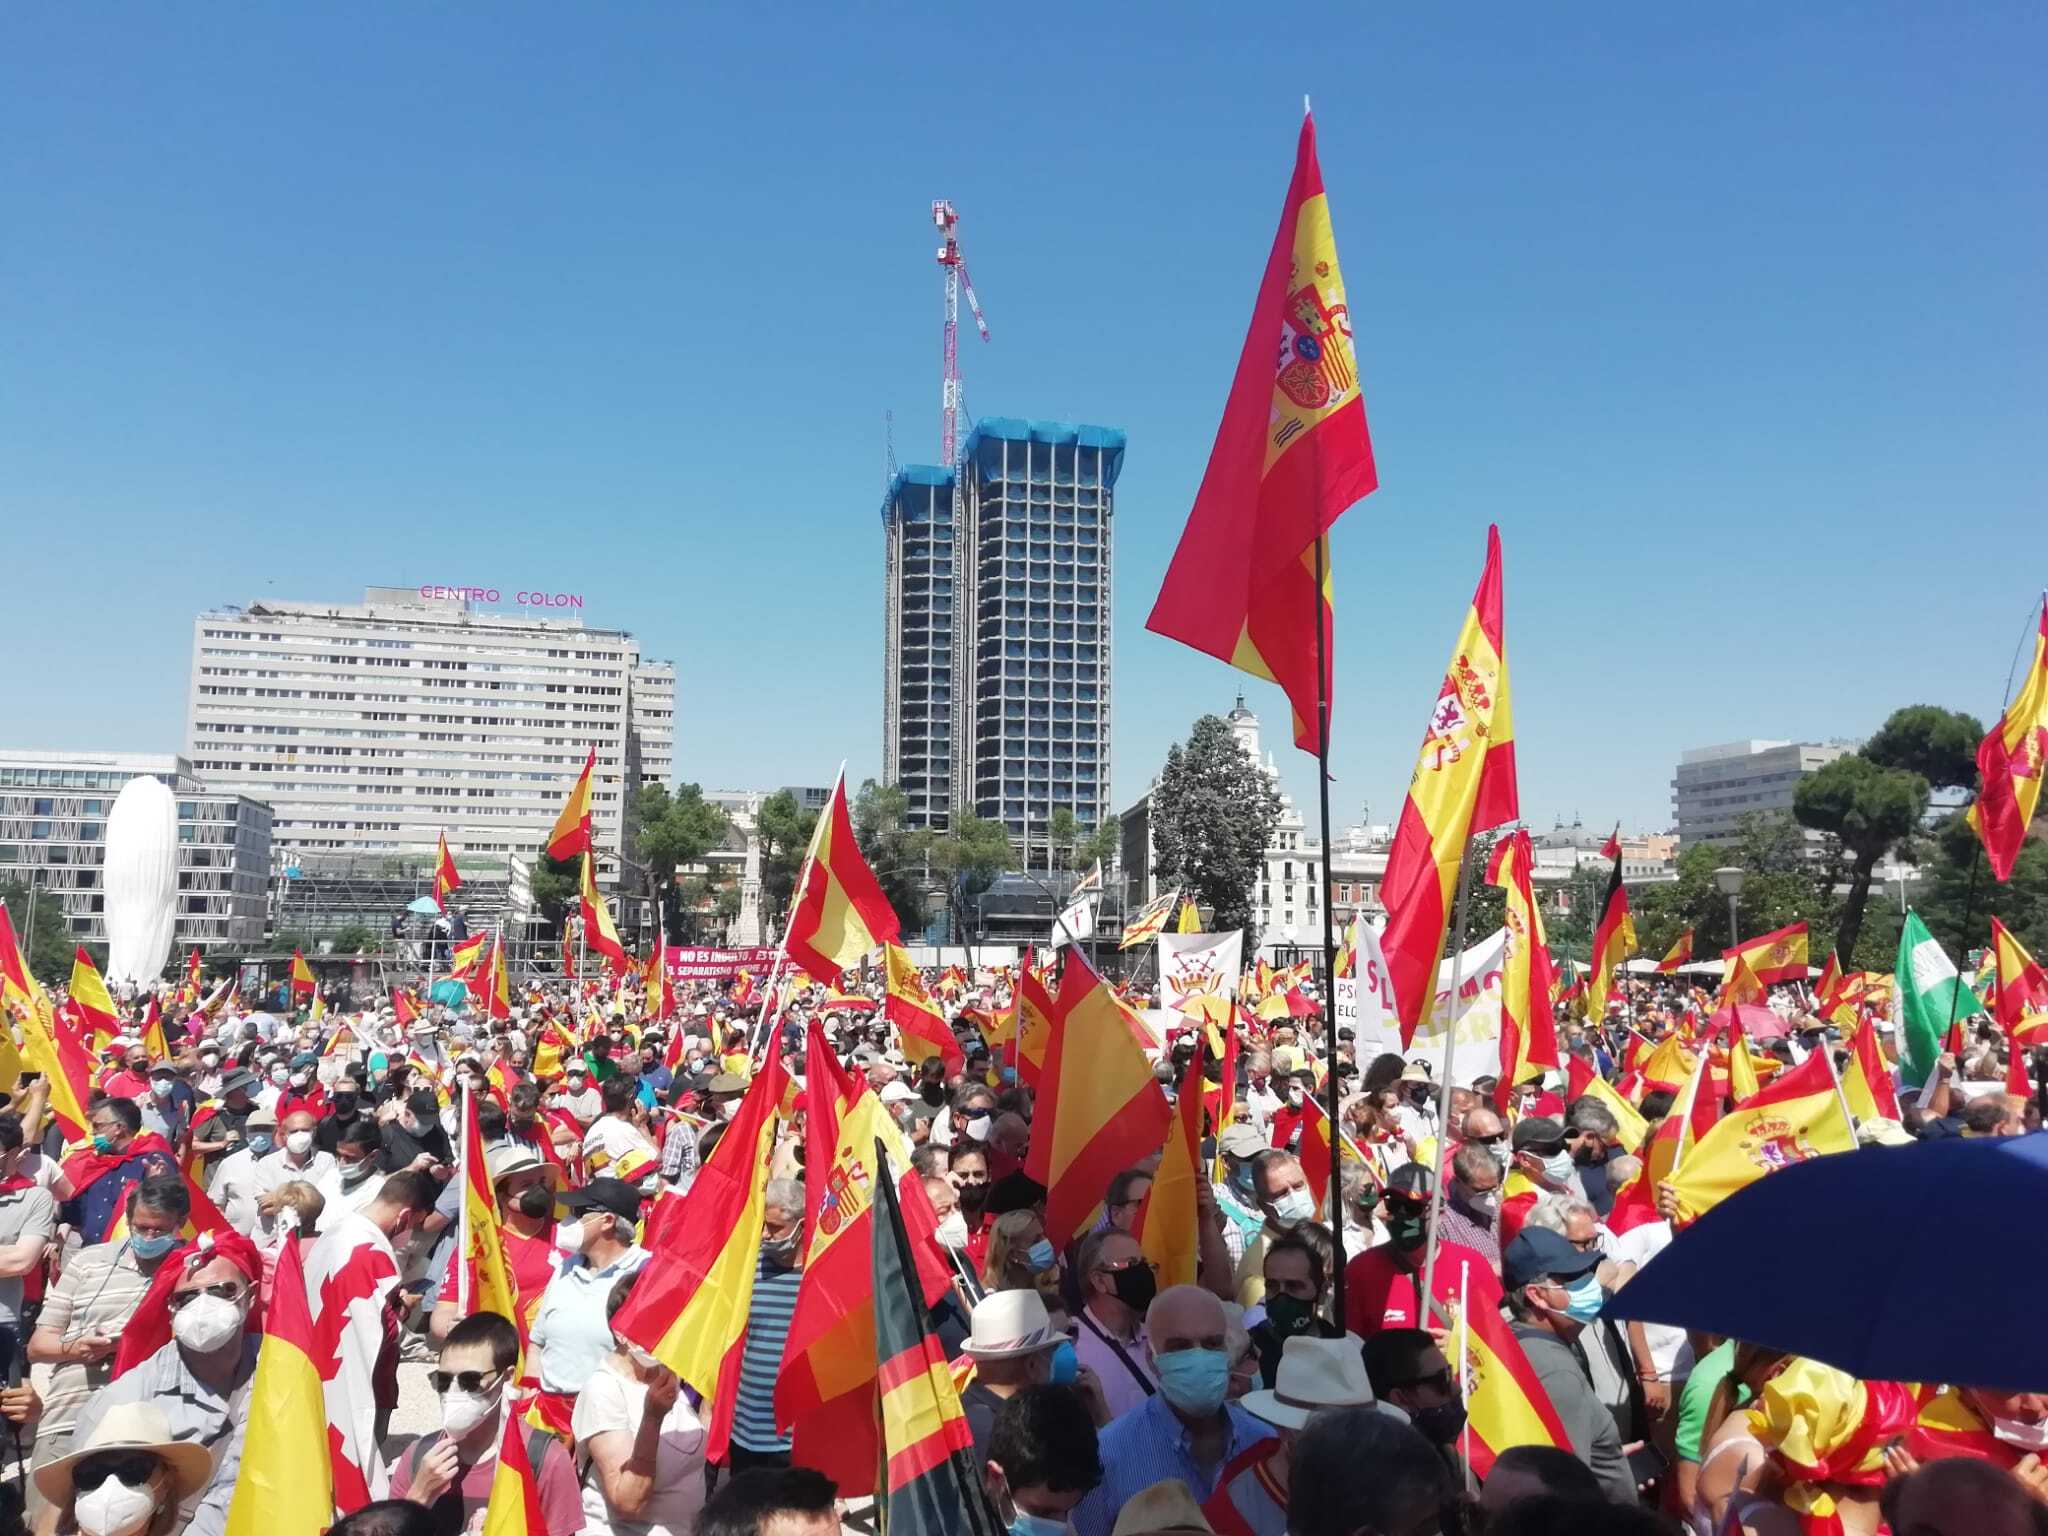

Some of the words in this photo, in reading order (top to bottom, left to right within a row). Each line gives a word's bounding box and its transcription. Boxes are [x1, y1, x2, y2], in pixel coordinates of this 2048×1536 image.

[420, 585, 500, 602] CENTRO
[516, 591, 583, 608] COLON
[680, 950, 695, 962] NO
[697, 950, 709, 962] ES
[677, 966, 732, 976] SEPARATISMO
[1338, 983, 1357, 999] PS
